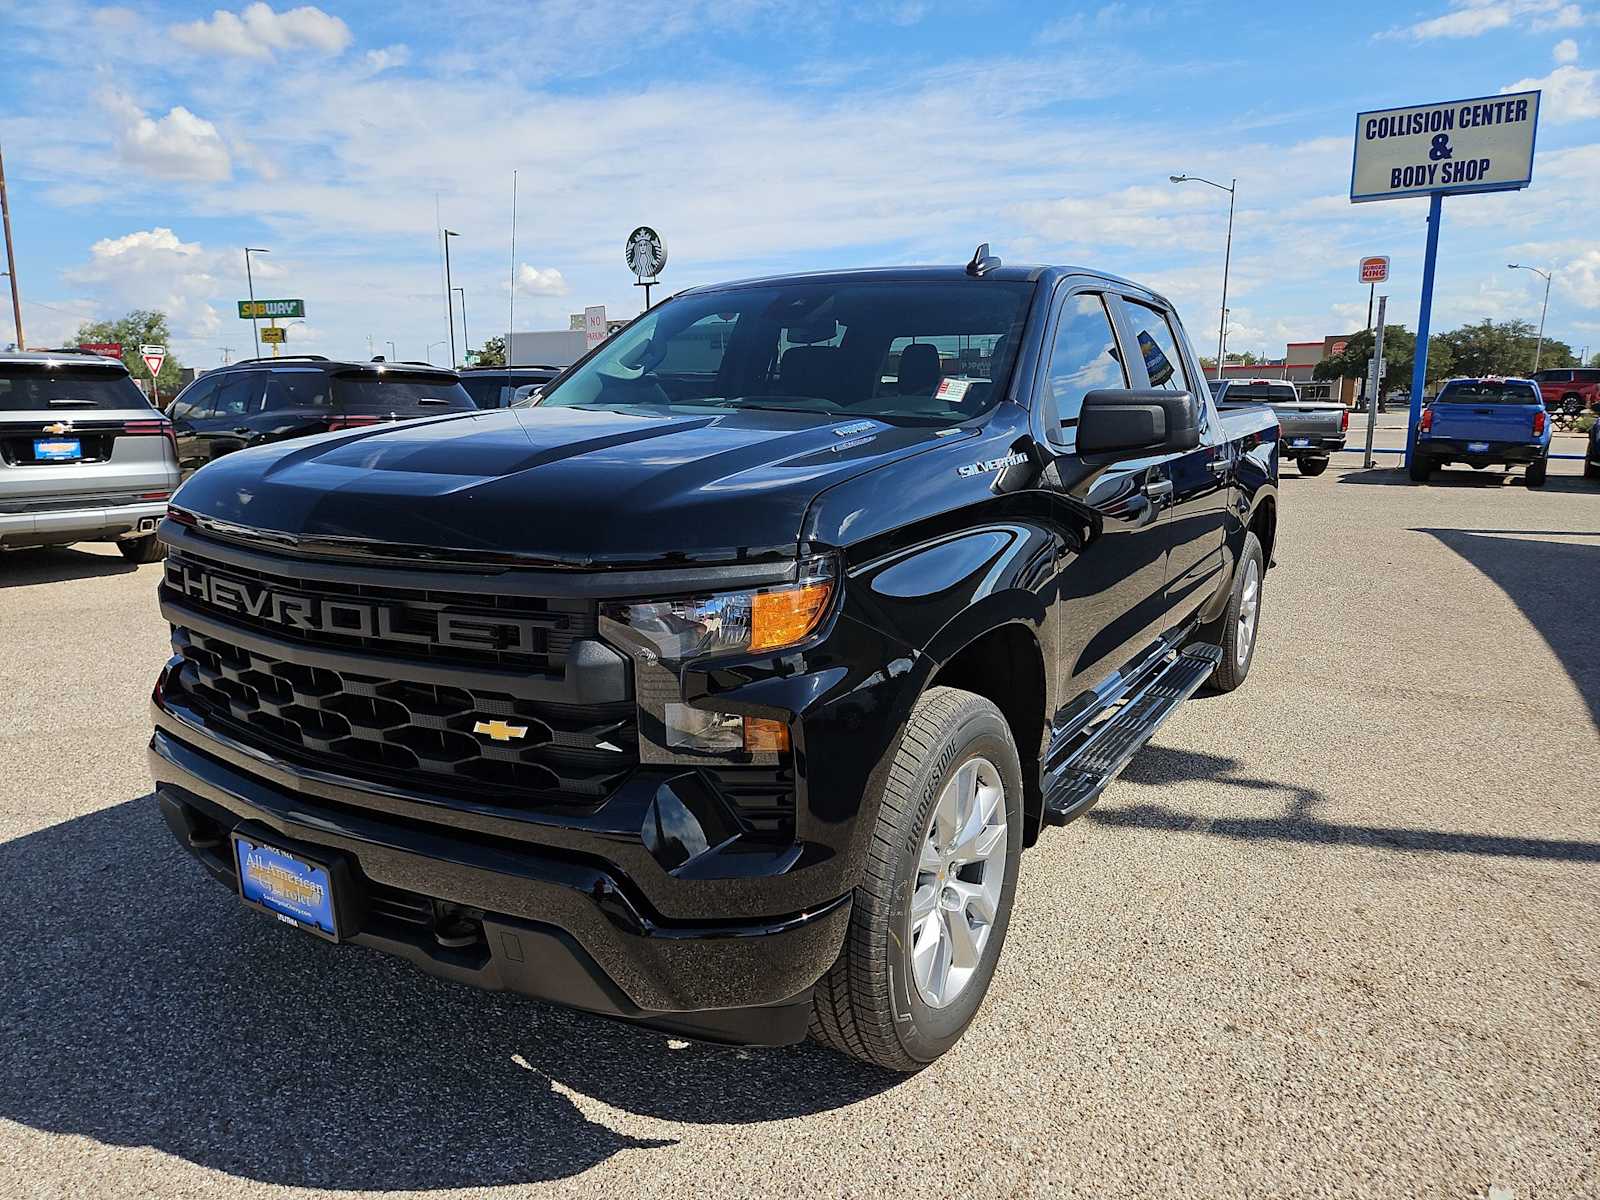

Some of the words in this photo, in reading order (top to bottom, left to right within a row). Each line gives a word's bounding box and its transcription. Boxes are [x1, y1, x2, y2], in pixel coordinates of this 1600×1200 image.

[1366, 108, 1454, 140] COLLISION
[1459, 99, 1528, 129] CENTER
[1429, 133, 1453, 161] &
[1391, 163, 1438, 189] BODY
[1441, 158, 1490, 183] SHOP
[1363, 269, 1386, 278] KING
[241, 302, 296, 316] SUBWAY
[590, 315, 601, 327] NO
[958, 452, 1029, 478] SILVERADO
[163, 556, 561, 653] CHEVROLET
[903, 737, 958, 857] BRIDGESTONE
[246, 852, 263, 871] All
[267, 860, 324, 896] American
